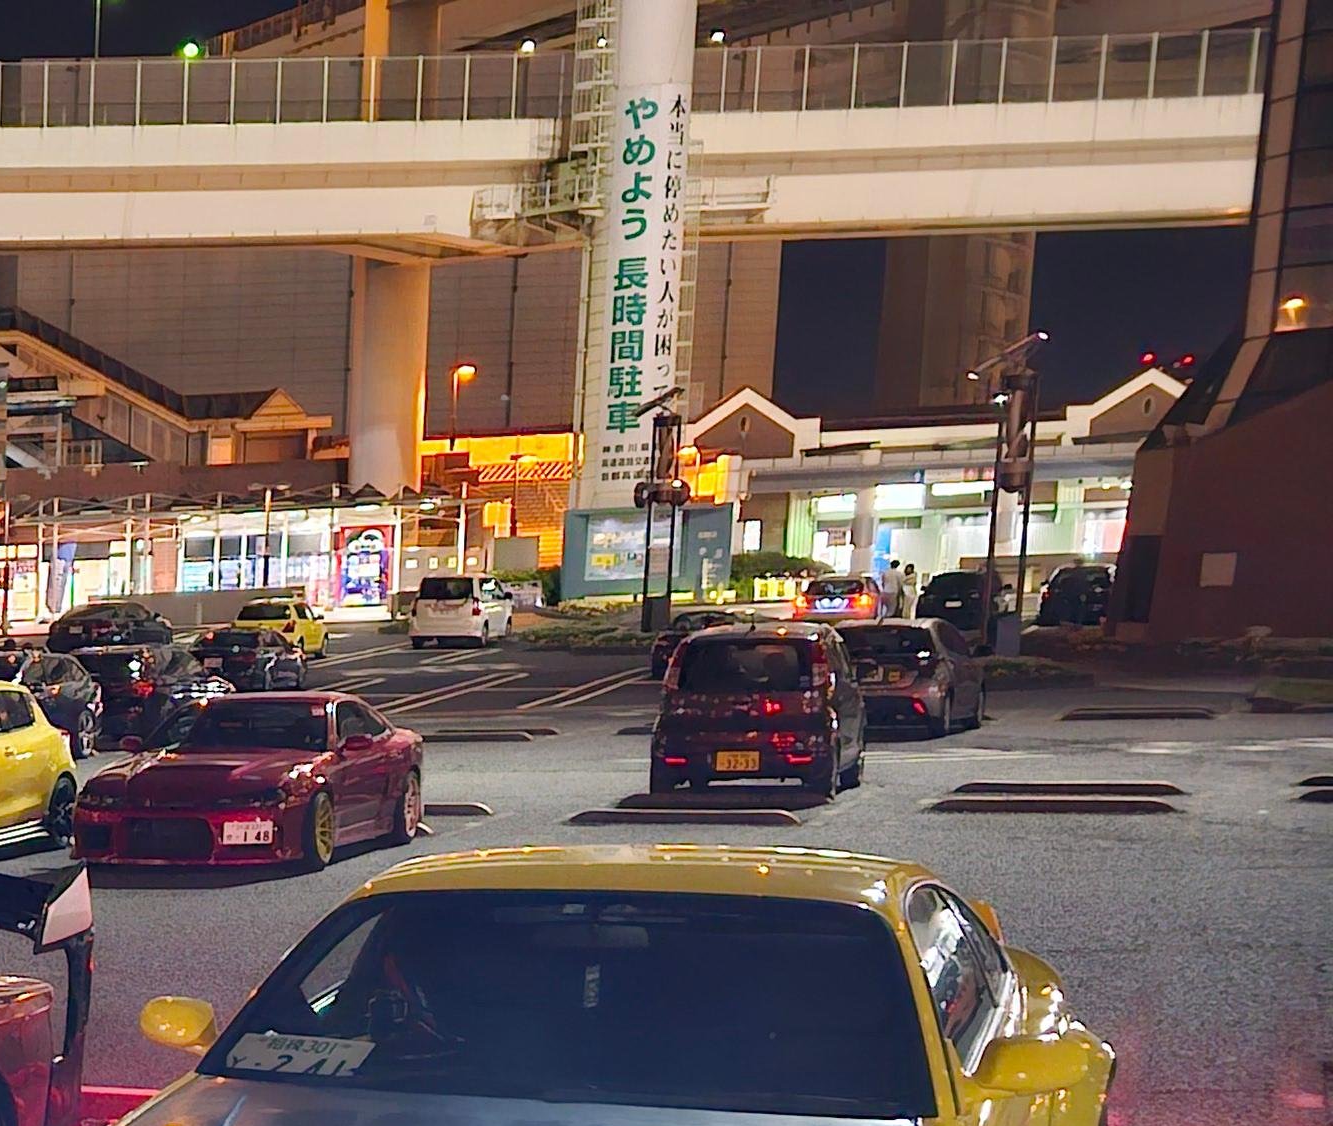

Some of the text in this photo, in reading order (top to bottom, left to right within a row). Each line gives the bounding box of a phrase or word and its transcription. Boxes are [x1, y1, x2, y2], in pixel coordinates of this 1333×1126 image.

[606, 97, 658, 434] やめよう 長時間駐車
